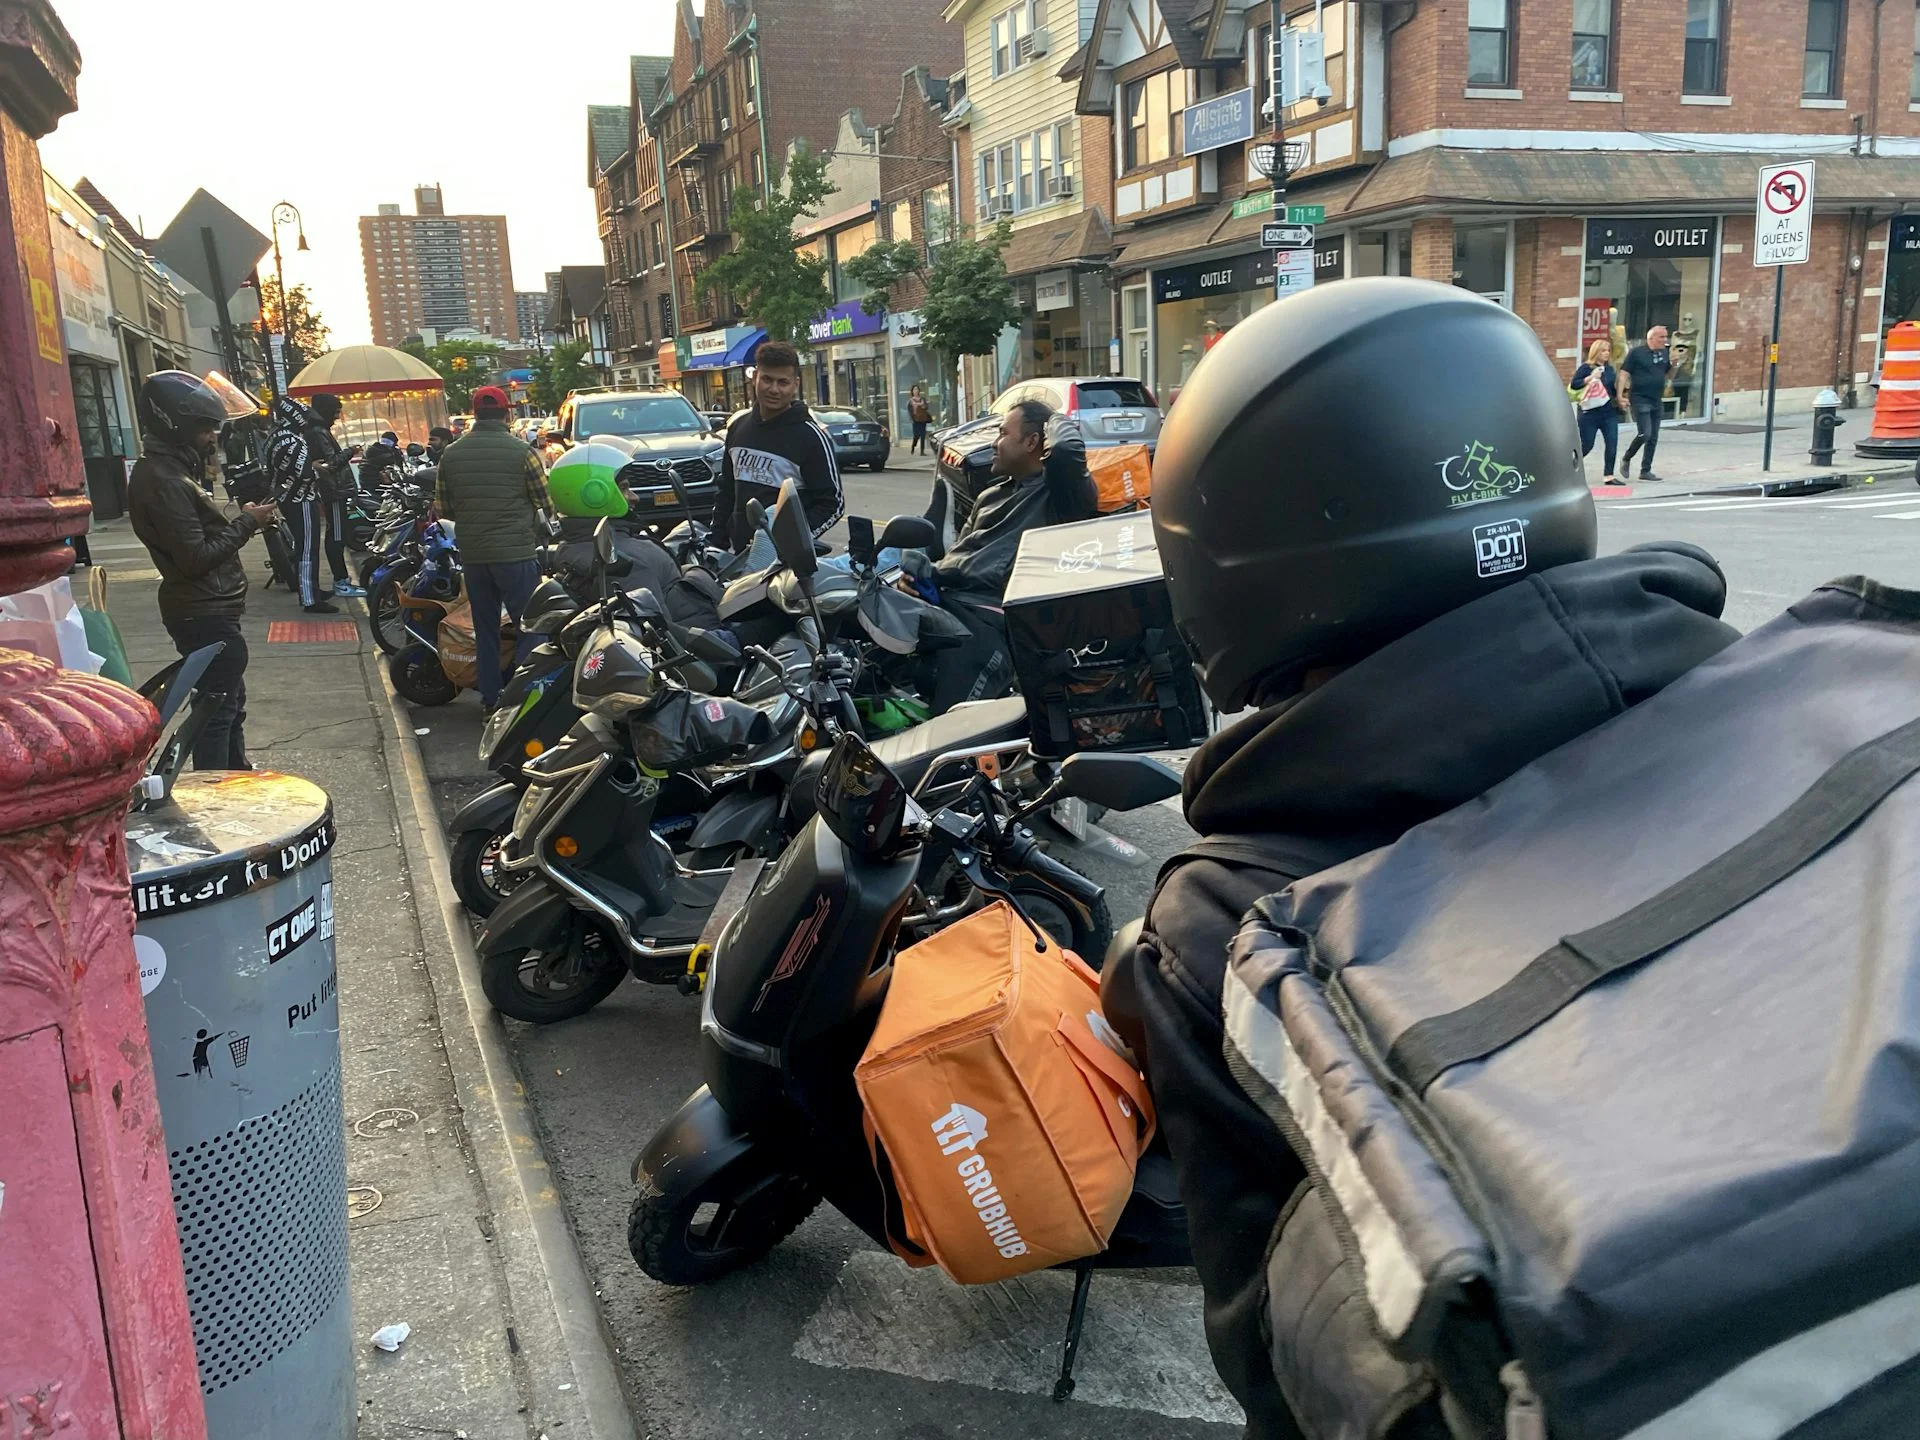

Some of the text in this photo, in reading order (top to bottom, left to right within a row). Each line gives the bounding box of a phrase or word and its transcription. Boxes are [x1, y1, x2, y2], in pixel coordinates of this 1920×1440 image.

[1191, 98, 1242, 135] Allstate
[1294, 208, 1305, 222] 71
[1776, 218, 1791, 230] AT
[1267, 231, 1308, 240] ONE WAY
[1654, 229, 1709, 247] OUTLET
[1762, 231, 1804, 245] QUEENS
[1313, 250, 1339, 269] TLET
[1603, 244, 1634, 256] MILANO
[1200, 269, 1234, 288] OUTLET
[1281, 275, 1288, 285] 3
[832, 313, 853, 336] bank
[1451, 489, 1503, 504] FLY E-BIKE
[1477, 531, 1522, 562] DOT
[281, 826, 328, 872] Don't
[269, 902, 316, 957] CT ONE
[287, 992, 318, 1029] Put
[957, 1154, 1027, 1259] GRUBHUB
